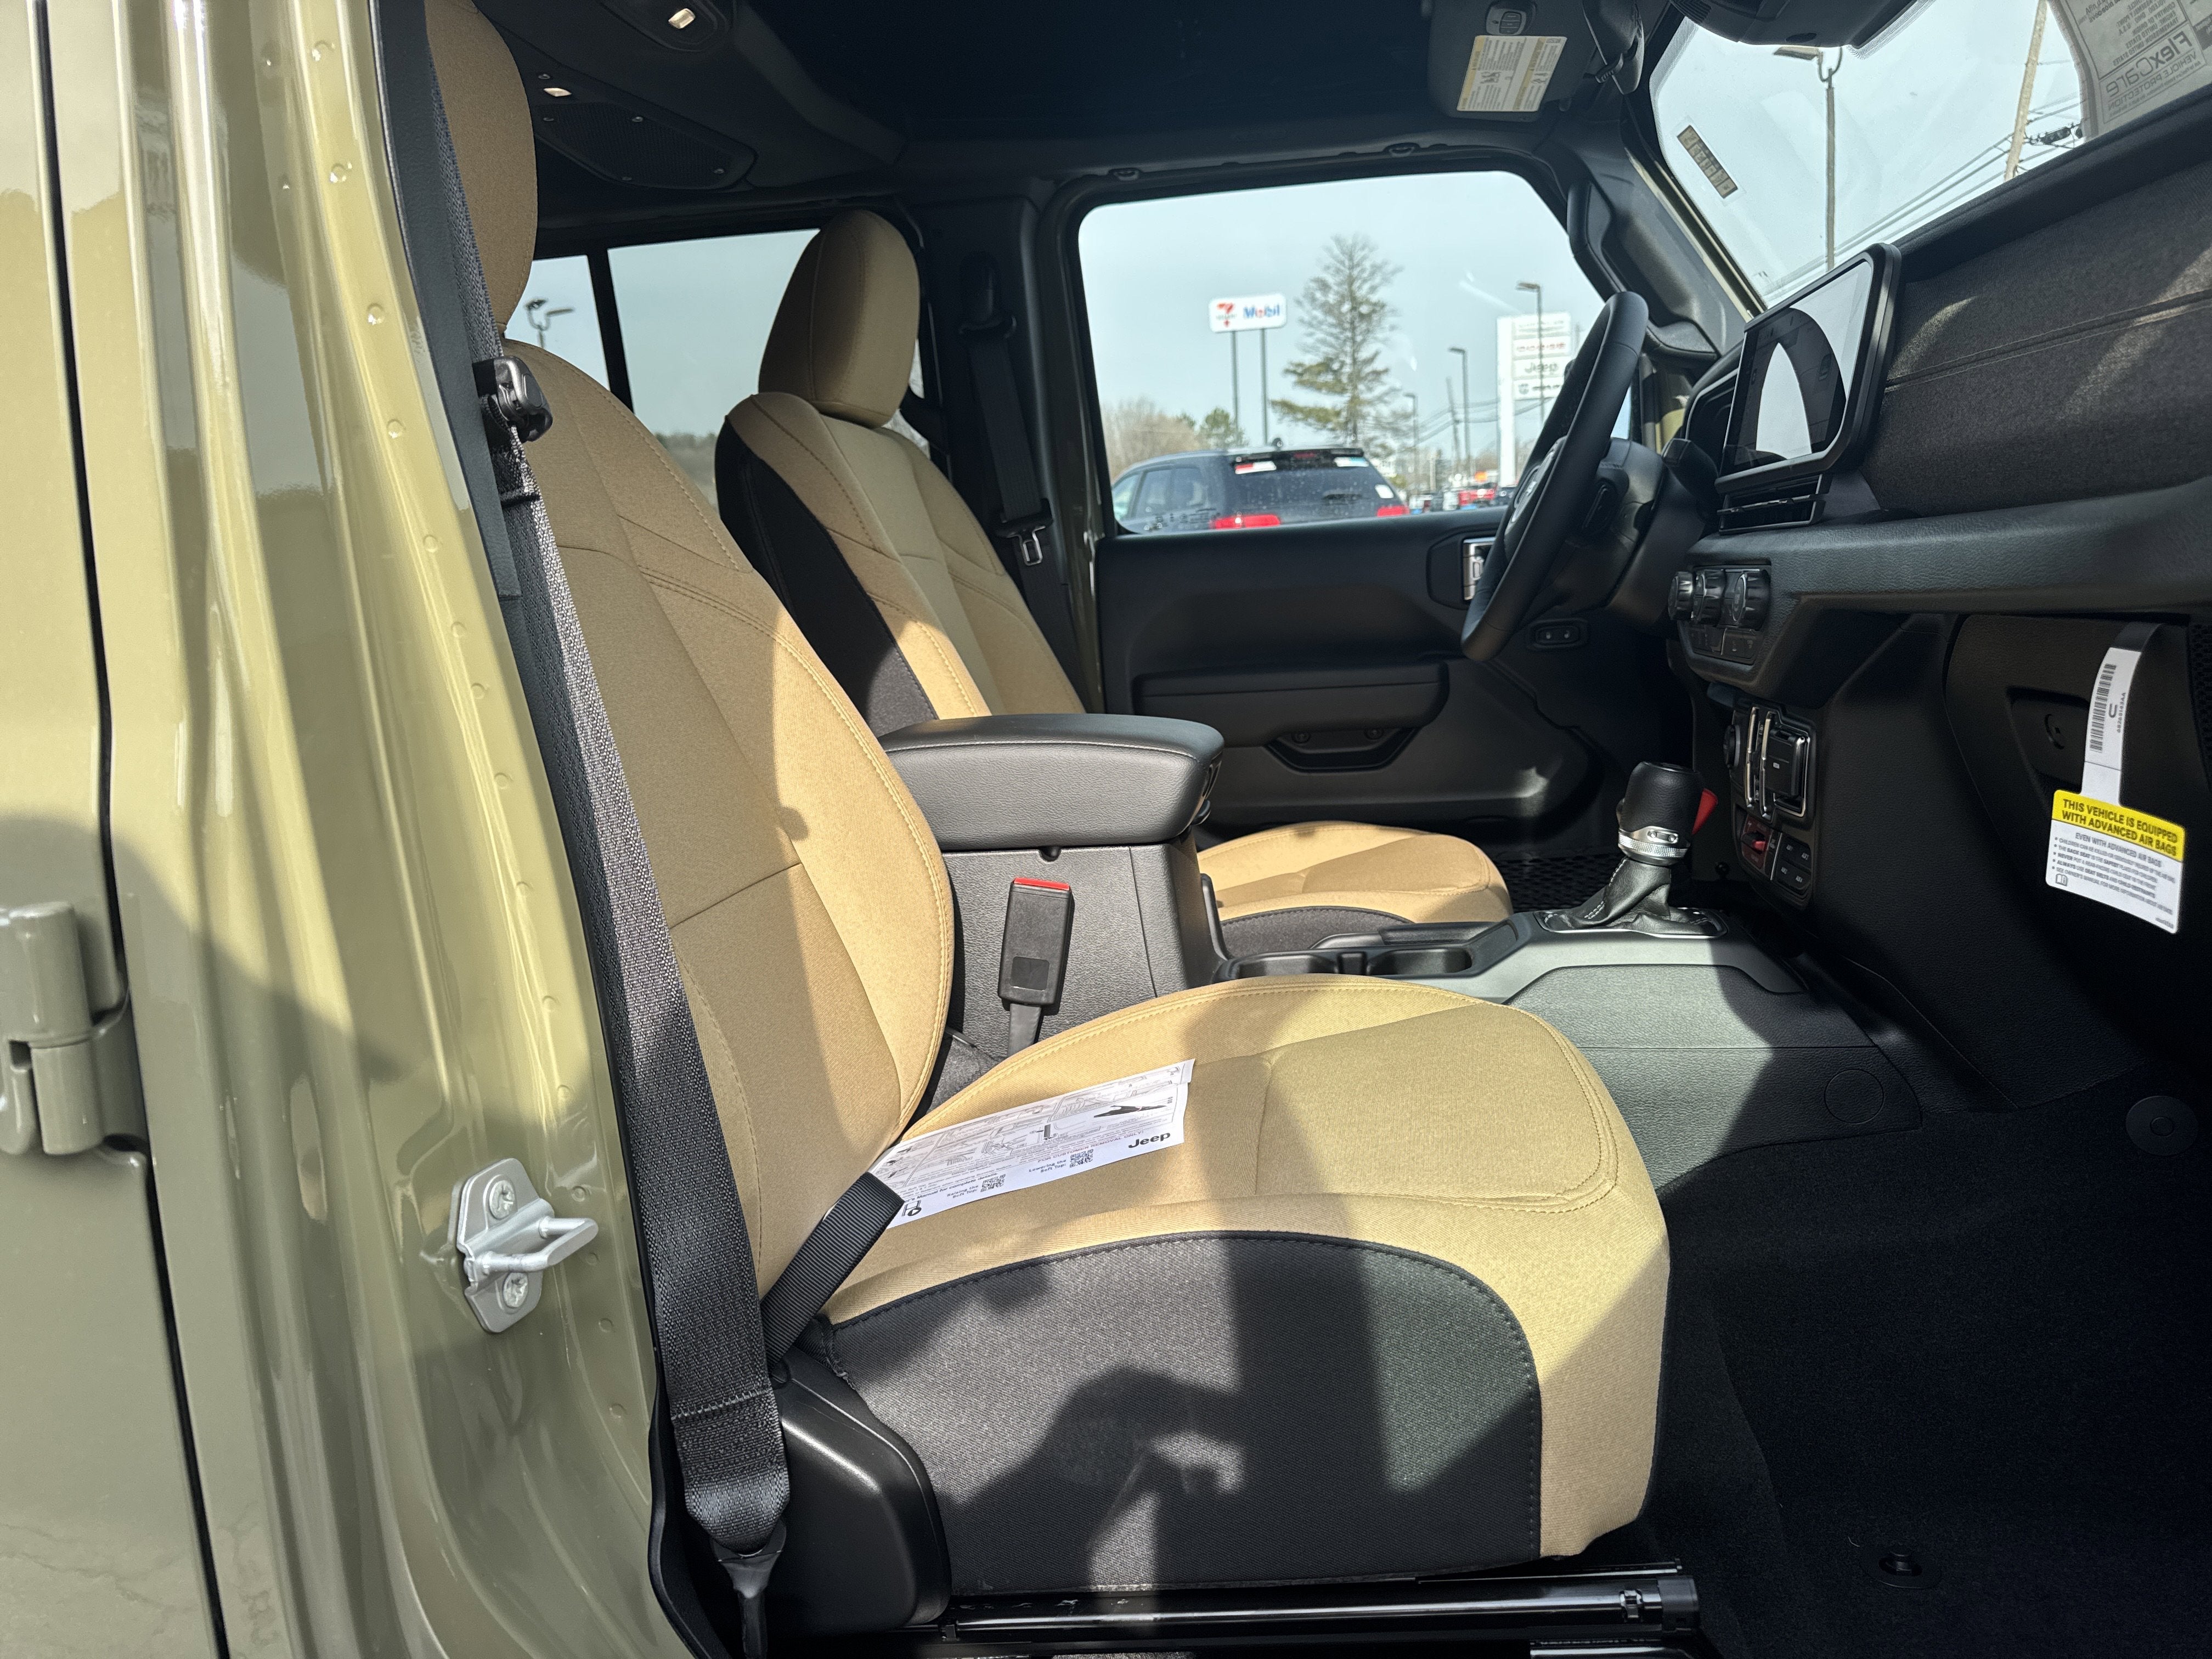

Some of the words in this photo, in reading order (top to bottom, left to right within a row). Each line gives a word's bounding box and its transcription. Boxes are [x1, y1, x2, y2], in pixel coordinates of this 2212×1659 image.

[1243, 304, 1280, 318] Mobil
[2063, 799, 2084, 812] THIS
[2087, 805, 2124, 824] VEHICLE
[2126, 817, 2135, 827] IS
[2137, 820, 2177, 843] EQUIPPED
[2062, 810, 2086, 825] WITH
[2089, 817, 2137, 840] ADVANCED
[2140, 834, 2153, 847] AIR
[2155, 840, 2176, 856] BAGS
[2075, 833, 2091, 842] EVEN
[2092, 837, 2107, 847] WITH
[2108, 843, 2136, 857] ADVANCED
[1091, 1137, 1122, 1149] REMOVAL
[1128, 1132, 1171, 1148] Jeep
